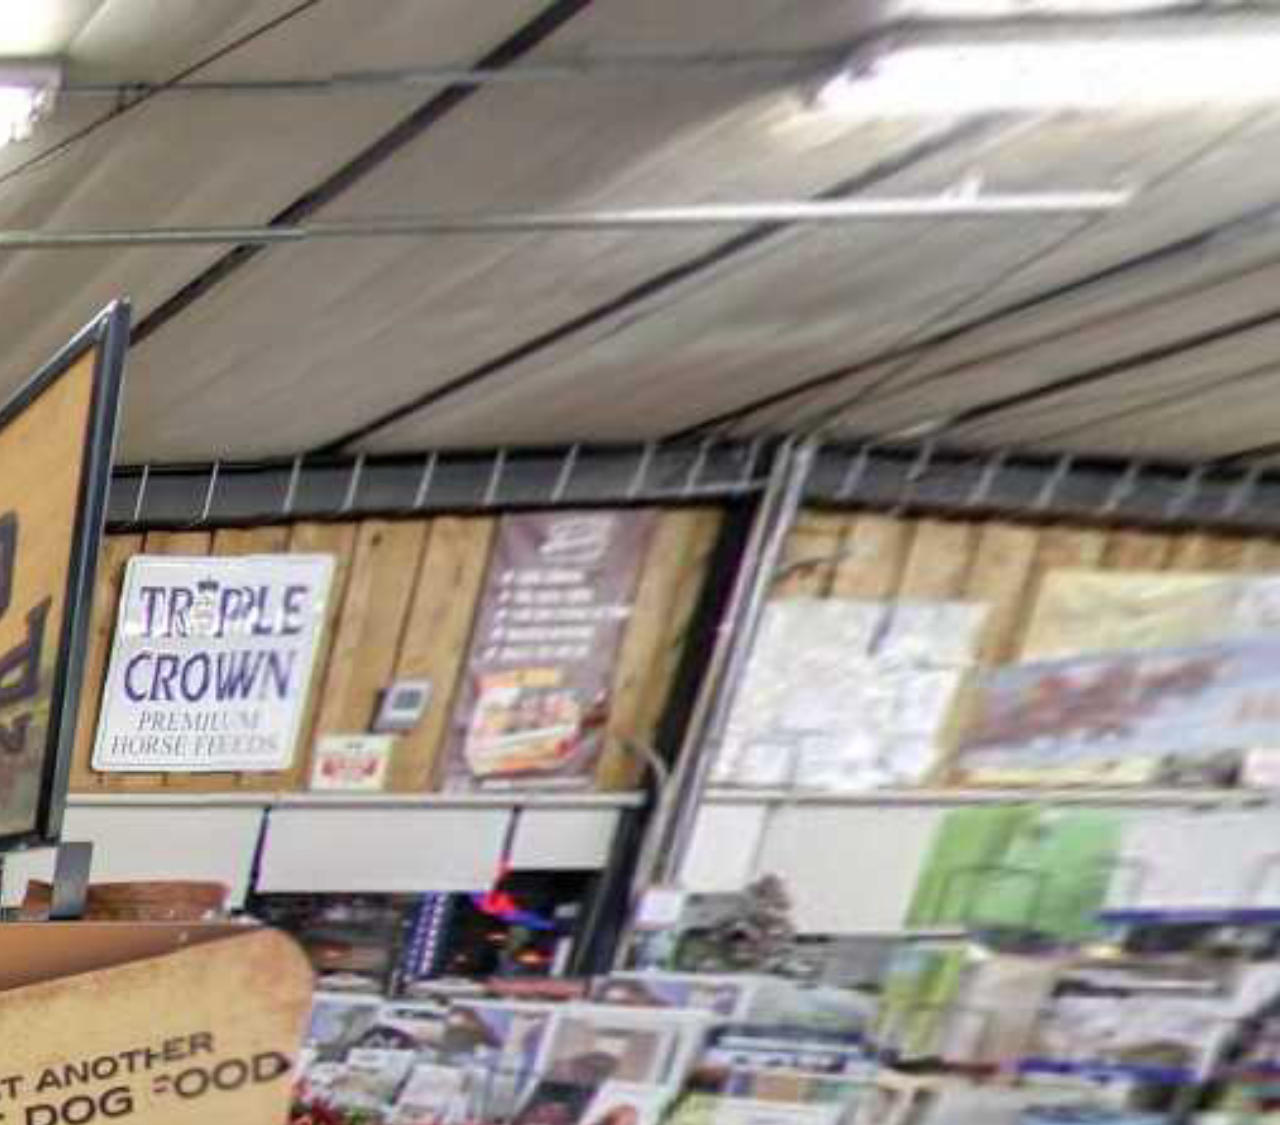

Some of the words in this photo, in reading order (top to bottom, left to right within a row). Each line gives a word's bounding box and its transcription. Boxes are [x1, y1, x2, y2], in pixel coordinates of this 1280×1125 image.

[123, 651, 297, 702] CROWN
[138, 710, 260, 732] PREMIUM
[111, 736, 186, 756] HORSE
[32, 1031, 215, 1093] ANOTHER
